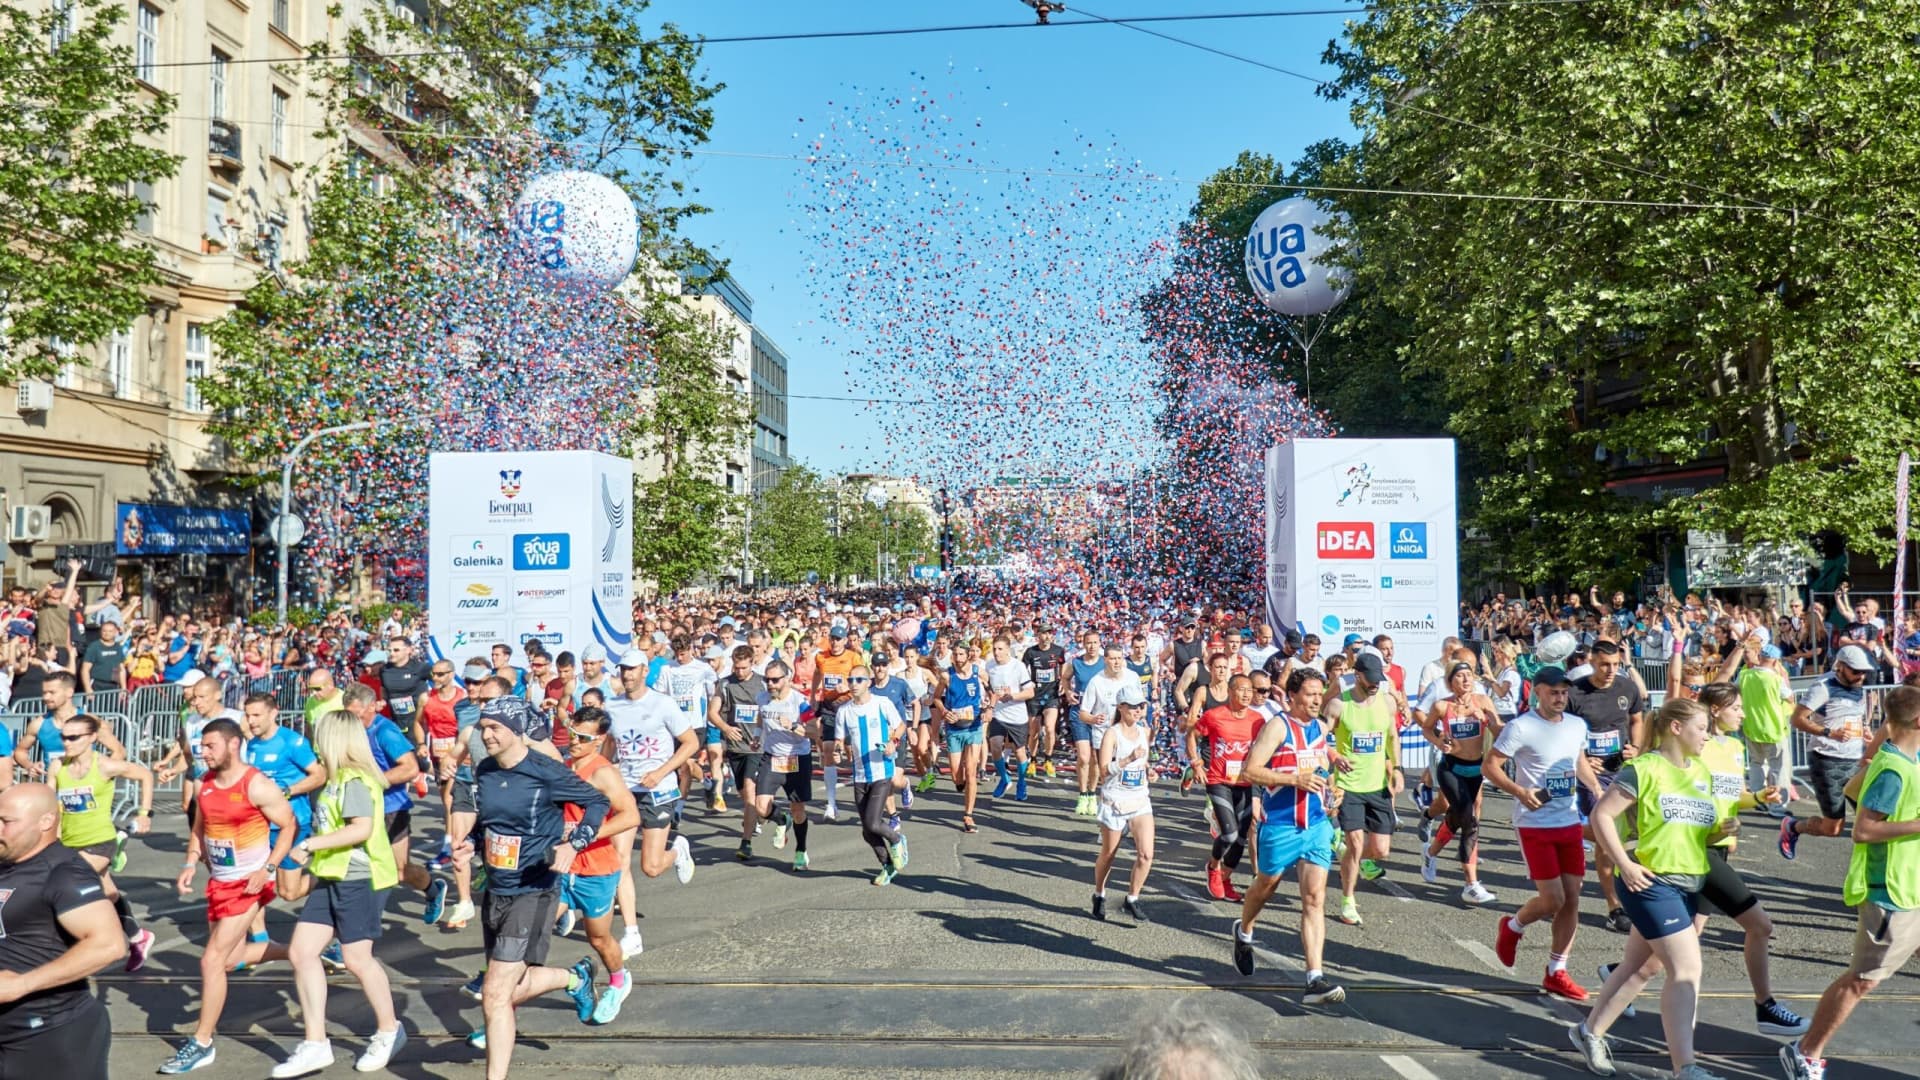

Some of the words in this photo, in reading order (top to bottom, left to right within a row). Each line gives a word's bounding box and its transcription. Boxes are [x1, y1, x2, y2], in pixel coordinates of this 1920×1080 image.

[488, 500, 533, 517] Београд
[523, 536, 560, 556] aqua
[1393, 545, 1424, 554] UNIQA
[453, 556, 504, 567] Galenika
[526, 552, 557, 566] viva
[523, 589, 565, 597] INTERSPORT
[1344, 617, 1365, 626] bright
[1383, 620, 1435, 630] GARMIN
[1344, 624, 1373, 633] marbles
[1356, 738, 1374, 748] 3715
[1547, 778, 1570, 790] 2449
[1663, 808, 1716, 825] ORGANISER
